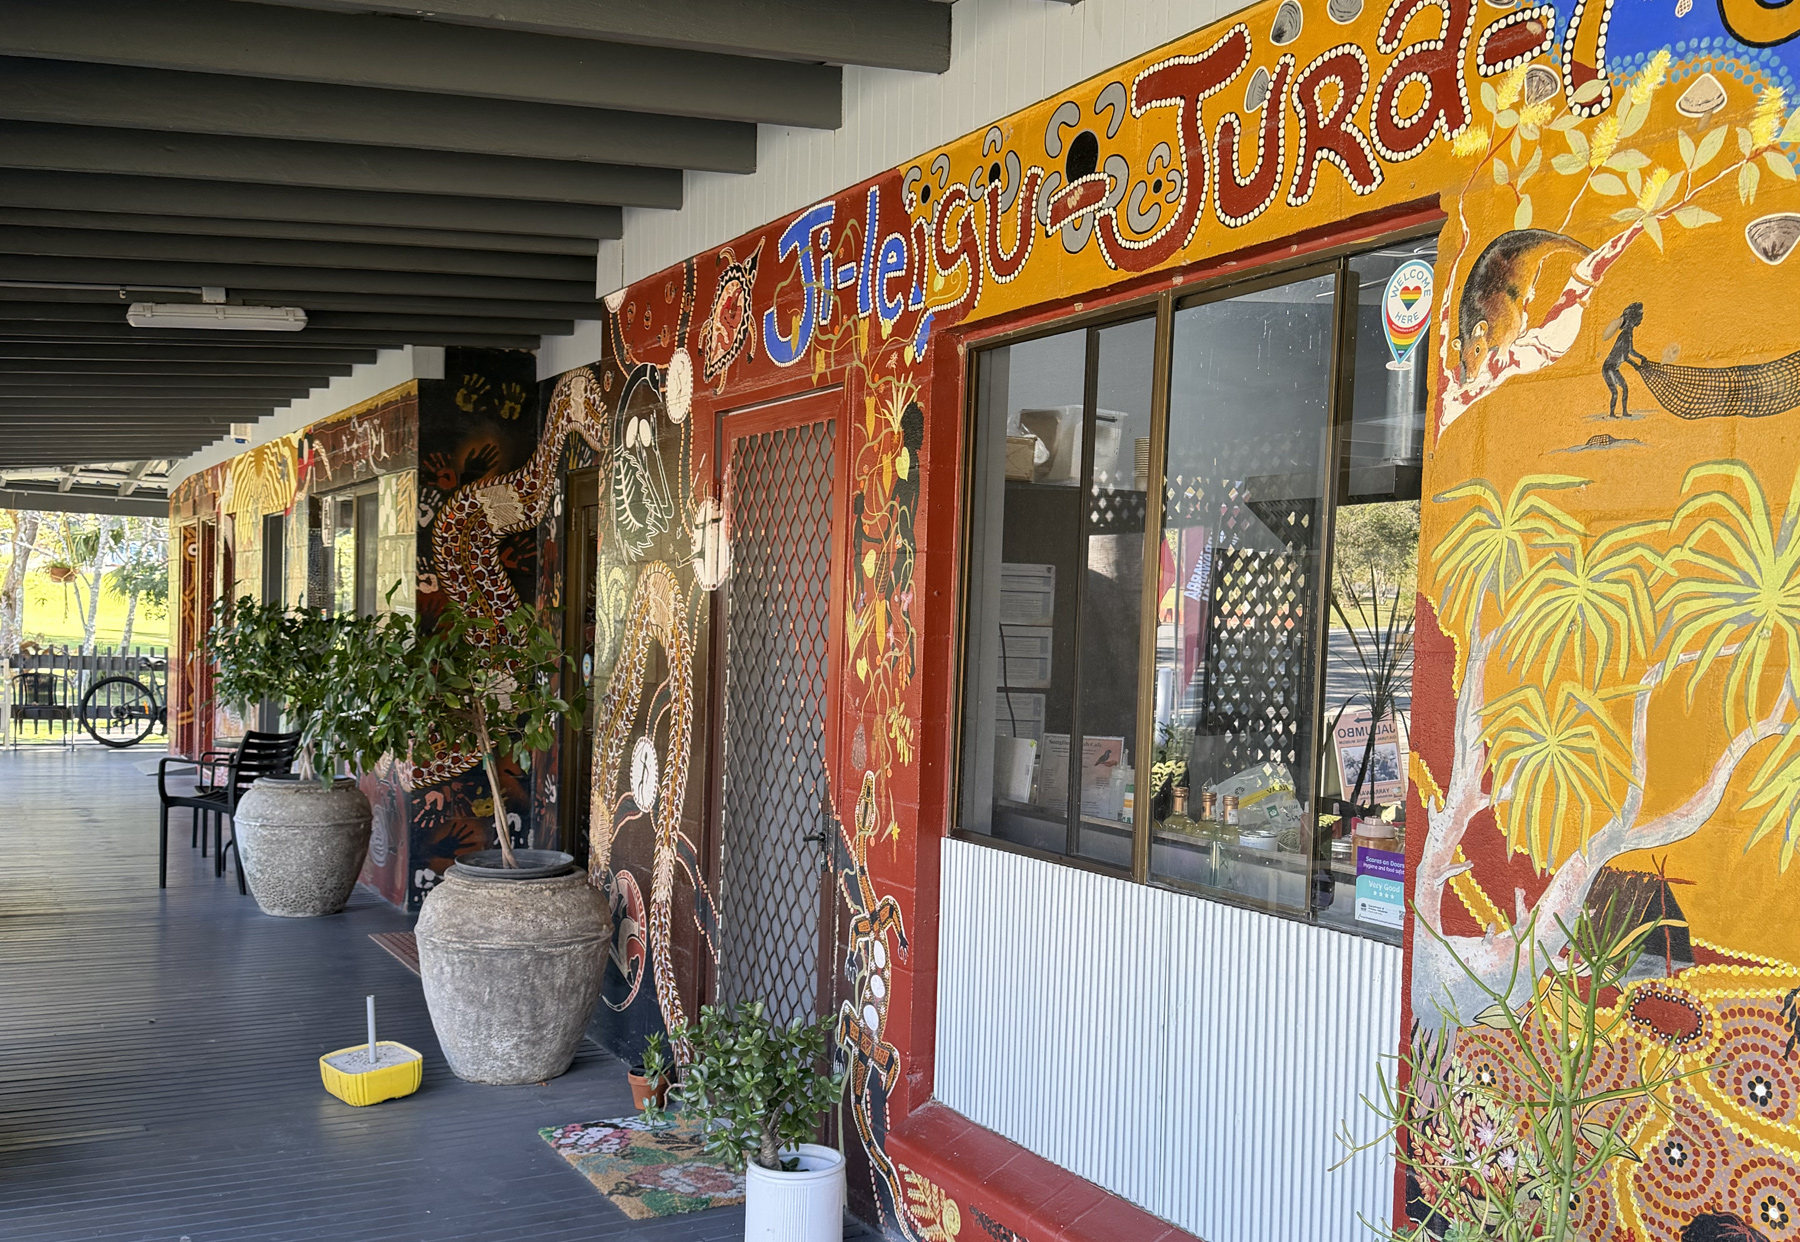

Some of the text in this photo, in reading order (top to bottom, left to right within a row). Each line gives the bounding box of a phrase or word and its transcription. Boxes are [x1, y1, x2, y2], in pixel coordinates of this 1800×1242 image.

[1390, 269, 1431, 298] WELCOME
[1395, 311, 1419, 324] HERE
[1365, 856, 1382, 865] Scores
[1390, 860, 1405, 869] Doors
[1368, 880, 1400, 893] Very Good
